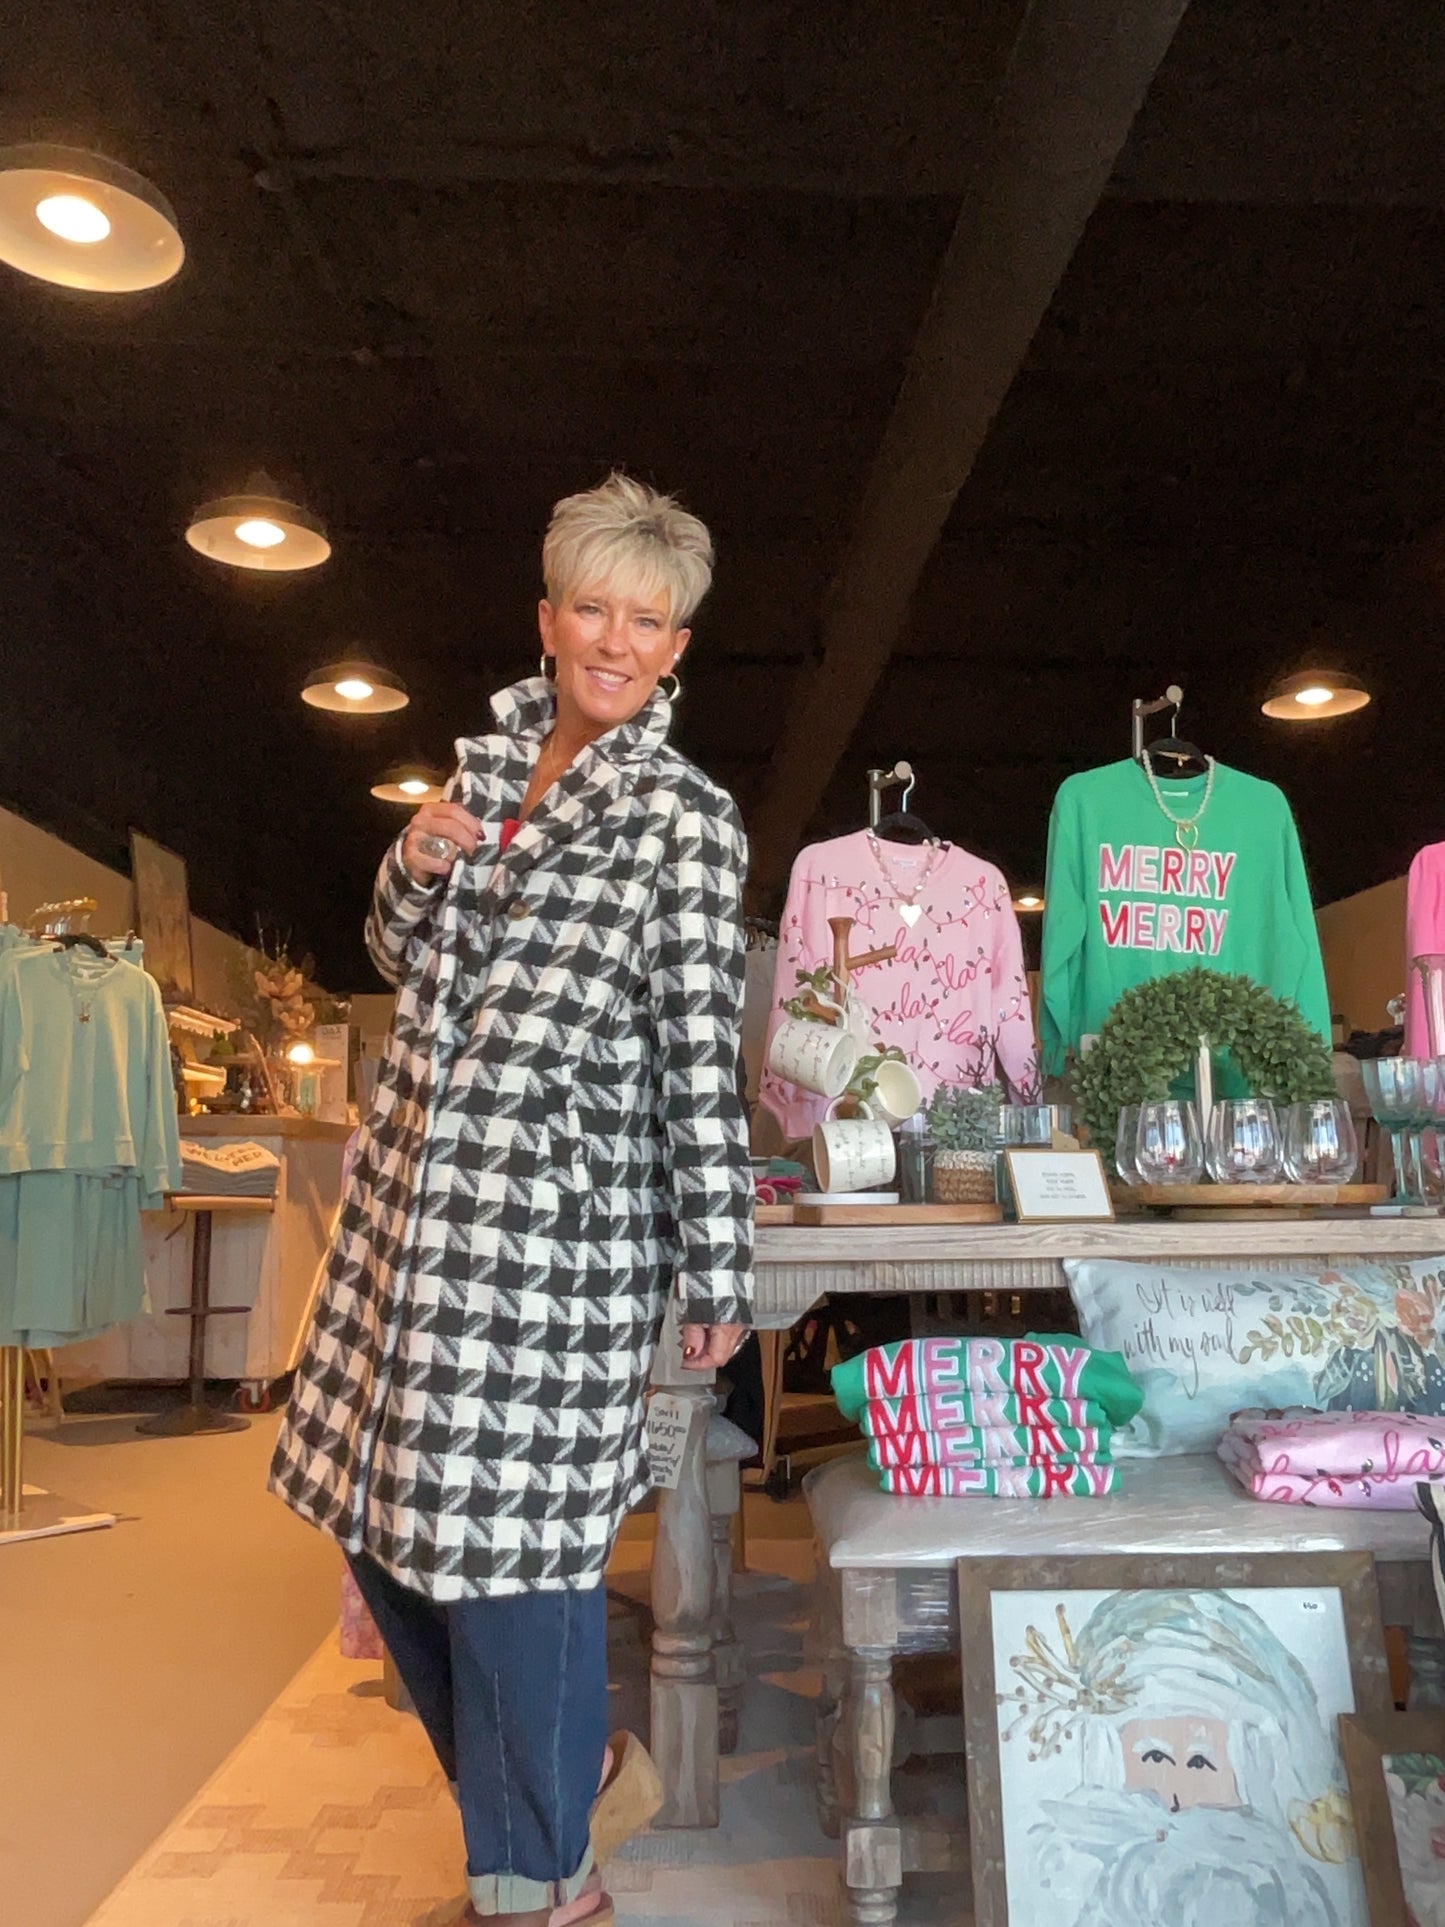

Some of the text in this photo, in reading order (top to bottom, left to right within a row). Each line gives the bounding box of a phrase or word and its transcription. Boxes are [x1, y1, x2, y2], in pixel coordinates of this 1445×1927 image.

[1099, 844, 1236, 900] MERRY
[1100, 900, 1228, 956] MERRY
[944, 953, 978, 990] la
[900, 982, 925, 1018] la
[1136, 1278, 1174, 1320] It
[1178, 1289, 1195, 1317] is
[865, 1338, 1091, 1398] MERRY
[1124, 1316, 1239, 1400] with my soul
